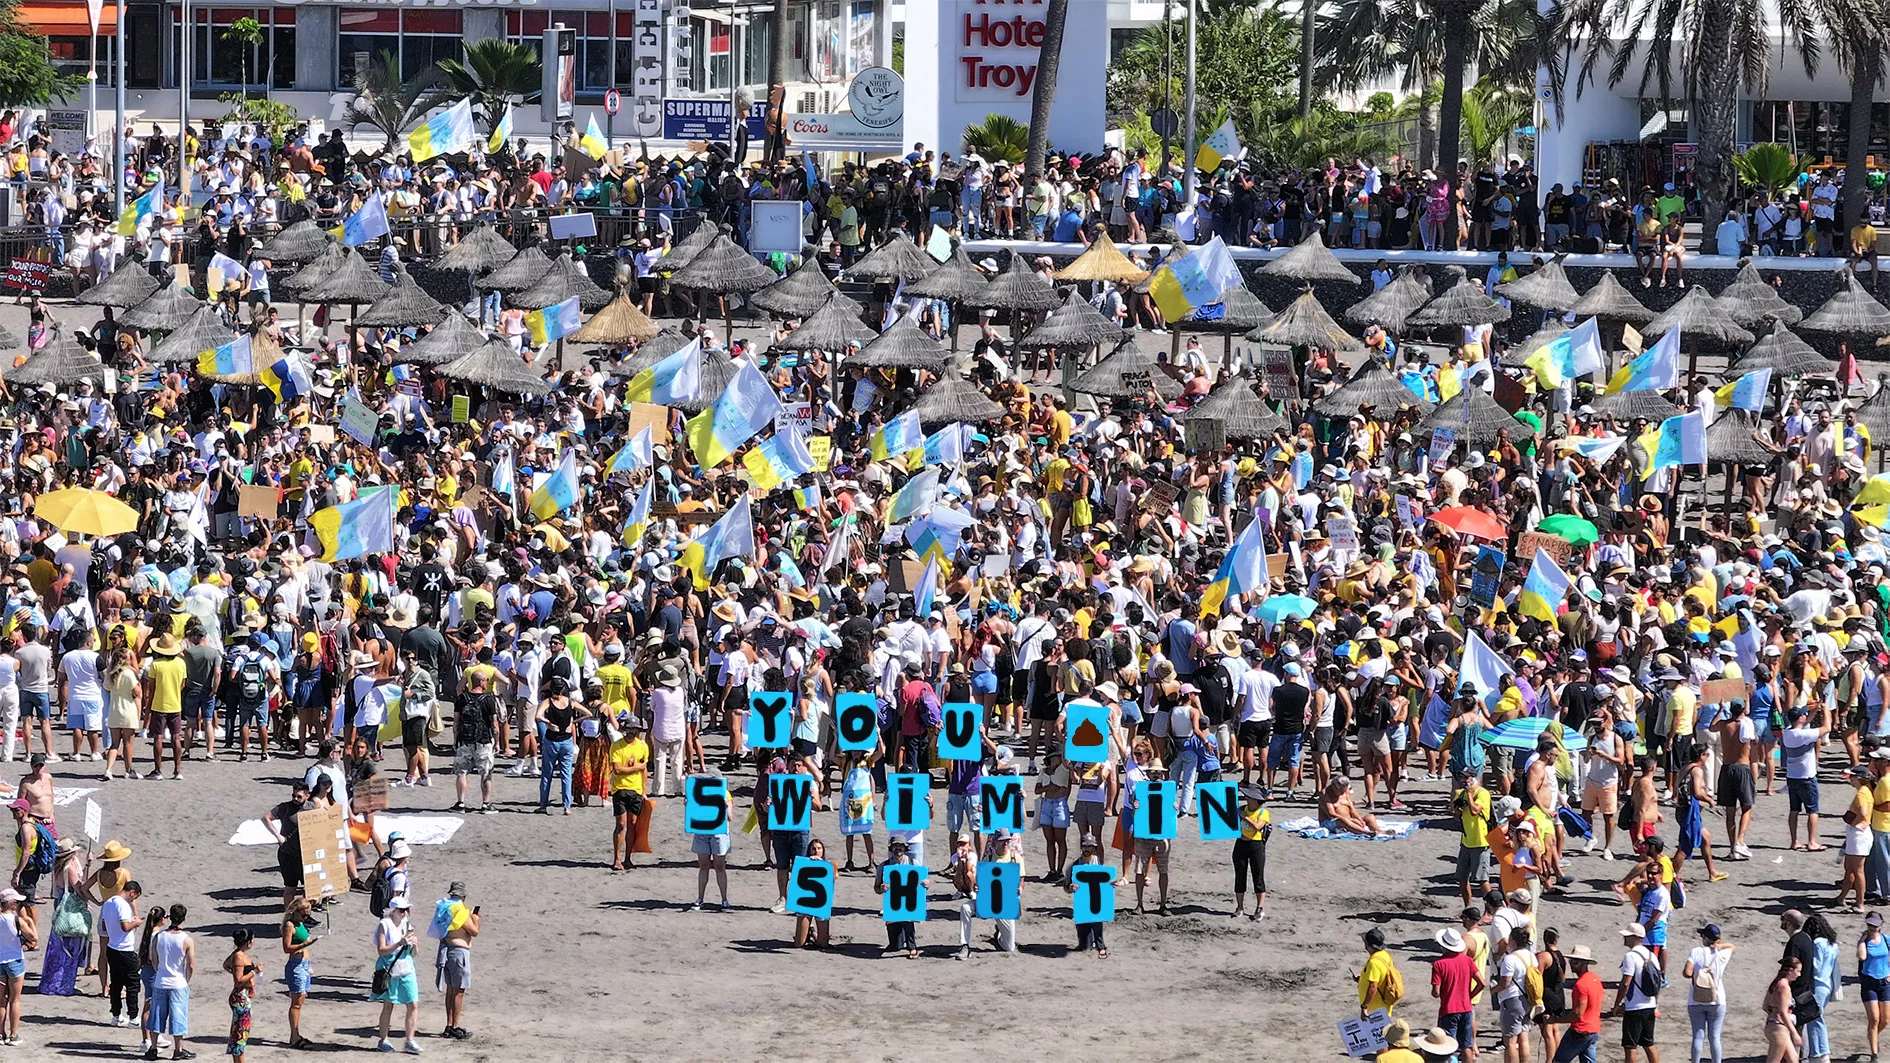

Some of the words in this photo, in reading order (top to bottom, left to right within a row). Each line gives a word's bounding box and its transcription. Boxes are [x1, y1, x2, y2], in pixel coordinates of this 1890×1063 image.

[963, 13, 1046, 47] Hote
[961, 56, 1037, 96] Troy
[667, 102, 767, 117] SUPERMAET
[793, 119, 828, 134] Coors
[862, 117, 893, 125] TENERIFE
[1521, 534, 1571, 555] CANARIAS
[752, 696, 977, 749] YOU
